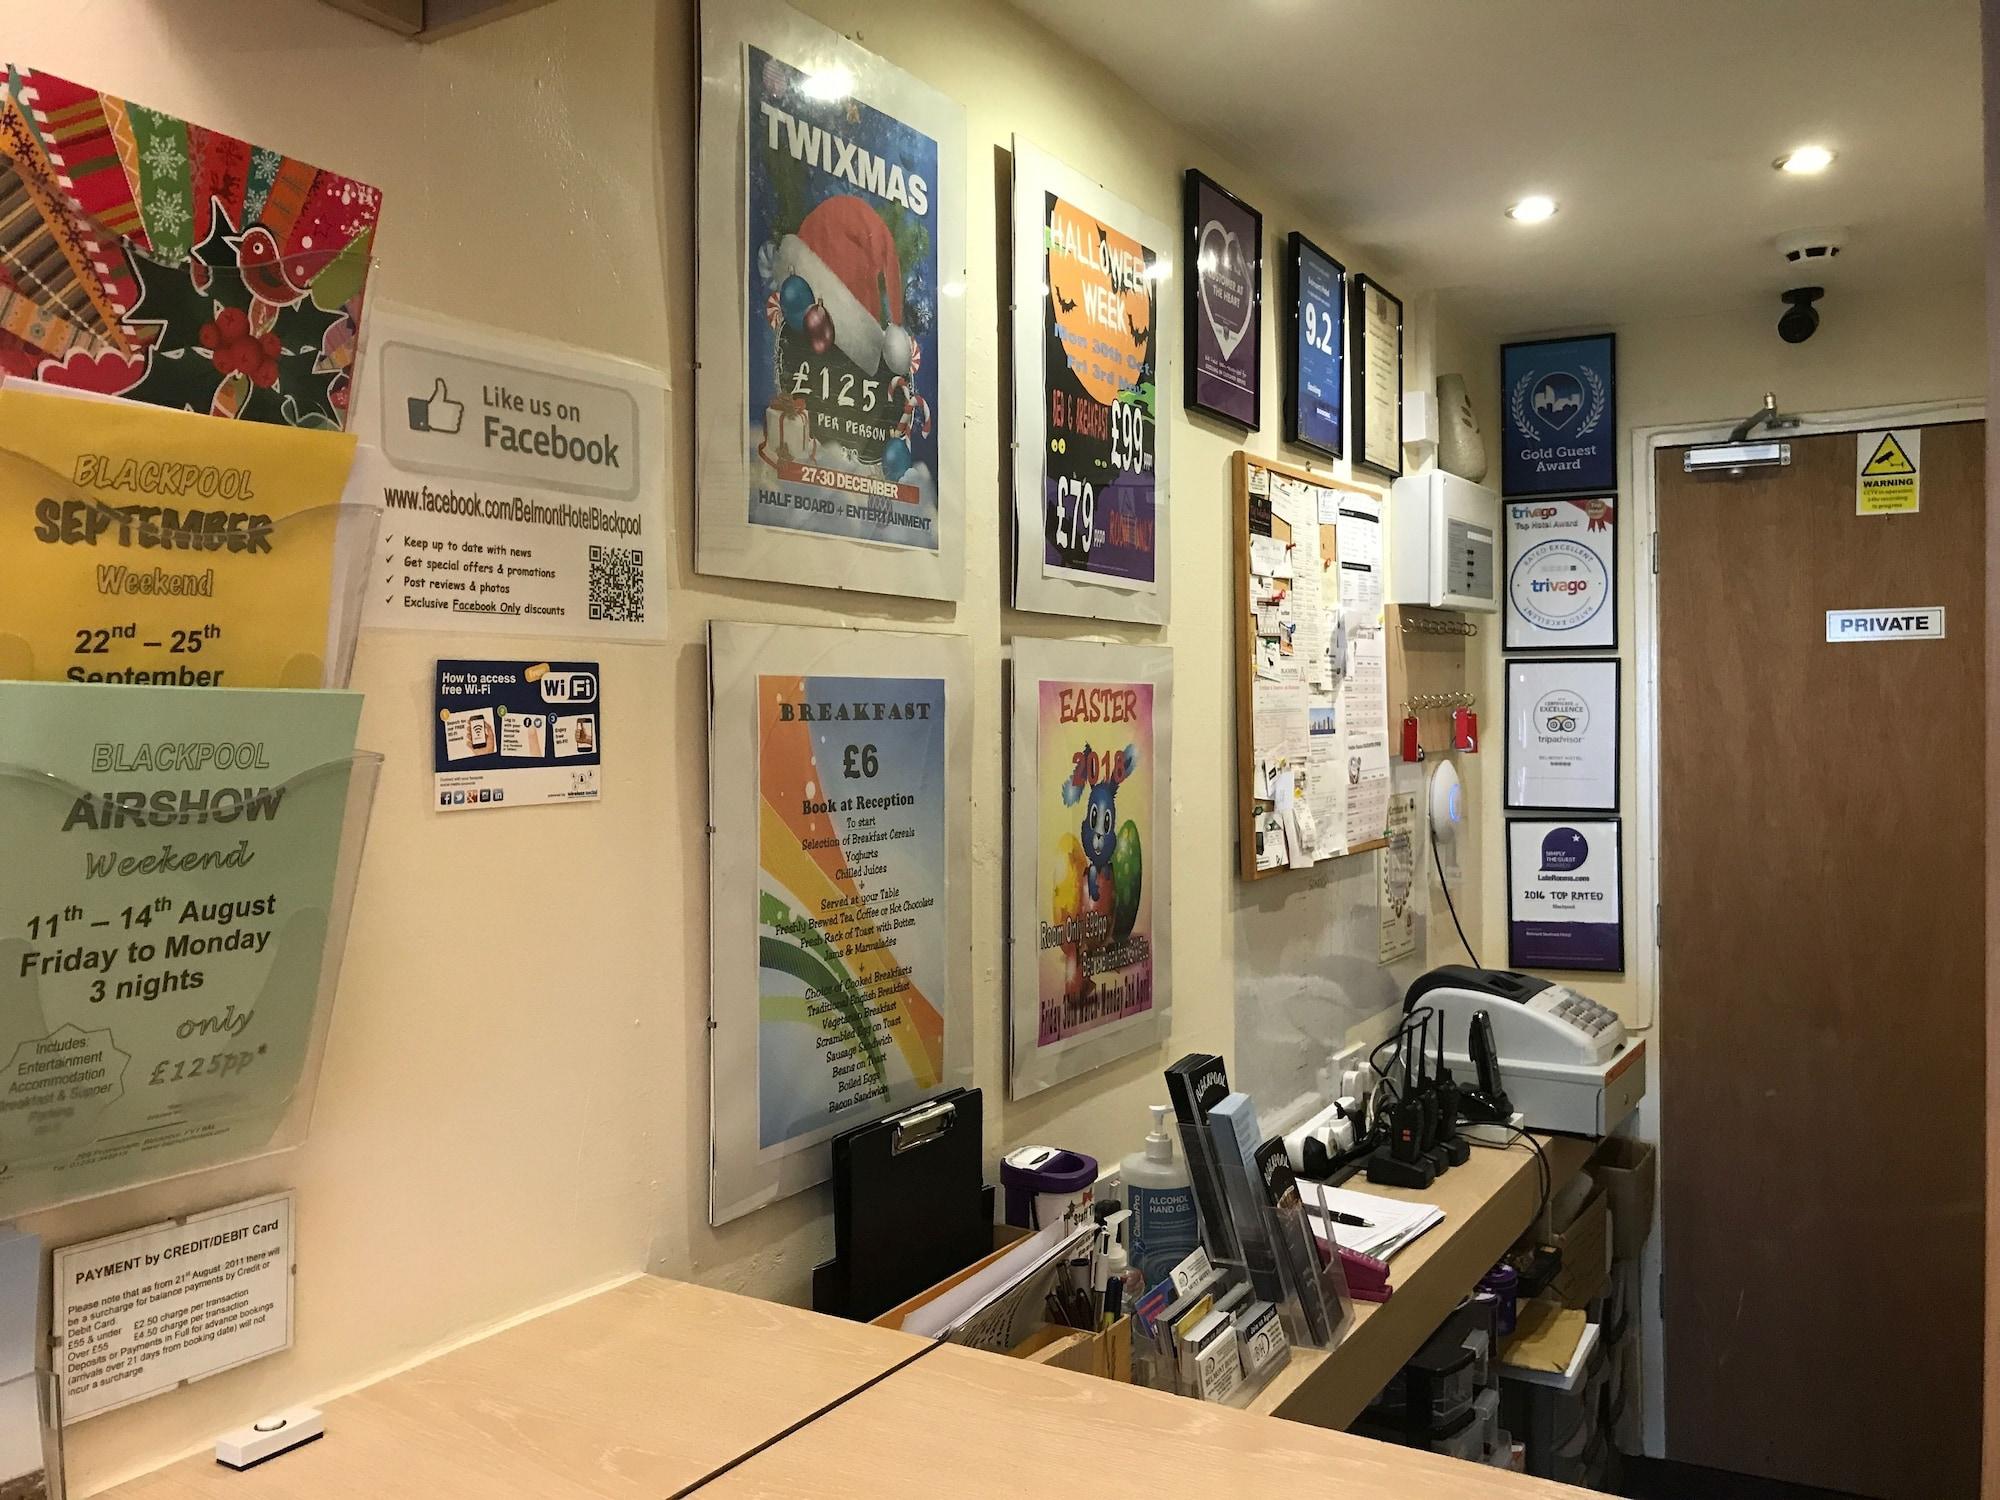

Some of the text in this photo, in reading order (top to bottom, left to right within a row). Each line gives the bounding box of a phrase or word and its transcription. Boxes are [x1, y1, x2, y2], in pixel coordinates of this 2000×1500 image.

[760, 100, 929, 216] TWIXMAS
[1082, 280, 1127, 333] WEEK
[1305, 302, 1333, 356] 9.2
[791, 360, 880, 412] £125
[482, 385, 580, 423] Like us on
[817, 411, 886, 441] PER PERSON
[1111, 398, 1144, 475] £99
[483, 415, 620, 469] Facebook
[1520, 445, 1597, 461] Gold Guest
[73, 453, 254, 500] BLACKPOOL
[1536, 459, 1581, 473] Award
[801, 465, 899, 499] 27-30 DECEMBER
[1863, 478, 1914, 488] WARNING
[384, 485, 642, 539] www.facebook.com/BelmontHotelBlackpool
[758, 489, 792, 507] HALF
[794, 496, 835, 515] BOARD
[846, 504, 931, 531] ENTERTAINMENT
[1056, 475, 1094, 553] £79
[1511, 506, 1558, 520] trivago
[33, 497, 275, 554] SEPTEMBER
[403, 535, 532, 558] Keep up to date with news
[96, 564, 214, 597] Weekend
[404, 556, 556, 579] Get special offers & promotions
[404, 576, 510, 594] Post reviews & photos
[1530, 578, 1587, 595] trivago
[404, 595, 565, 616] Exclusive Facebook Only discounts
[75, 622, 221, 654] 22nd 25th
[1840, 615, 1930, 633] PRIVATE
[441, 684, 491, 695] free Wi-Fi
[442, 672, 517, 684] How to access
[779, 702, 931, 722] BREAKFAST
[1059, 687, 1137, 724] EASTER
[1538, 735, 1583, 744] tripadvisor
[91, 742, 270, 772] BLACKPOOL
[843, 743, 879, 779] £6
[1072, 750, 1126, 787] 2018
[61, 786, 287, 832] AIRSHOW
[802, 792, 915, 815] Book at Reception
[846, 816, 876, 829] To start
[801, 827, 915, 851] Selection of Breakfast Cereals
[85, 840, 255, 880] Weekend
[845, 849, 879, 864] Yoghurts
[835, 863, 888, 881] Chilled Juices
[1537, 874, 1590, 882] LateRooms.com
[820, 895, 849, 911] Served
[861, 893, 879, 906] your
[880, 888, 900, 901] Table
[1524, 890, 1604, 901] 2016 TOP RATED
[26, 894, 276, 940] 11th 14th August
[1040, 921, 1063, 950] Room
[1066, 915, 1083, 946] Only
[19, 927, 271, 978] Friday to Monday
[89, 967, 205, 1003] 3 nights
[176, 1005, 255, 1040] only
[35, 1037, 89, 1056] Includes:
[17, 1051, 103, 1076] Entertainment
[8, 1067, 106, 1095] Accommodation
[1195, 1071, 1227, 1104] BLACKPOOL
[1149, 1195, 1189, 1205] ALCOHOL
[1149, 1203, 1190, 1214] HAND GEL
[76, 1219, 279, 1285] PAYMENT by CREDIT/DEBIT Card
[67, 1261, 270, 1327] be a surcharge for balance payments by Credit or
[68, 1300, 99, 1315] Please
[101, 1294, 121, 1305] note
[122, 1288, 140, 1300] that
[141, 1285, 152, 1295] as
[154, 1279, 173, 1290] from
[192, 1264, 221, 1280] August
[224, 1257, 244, 1270] 2011
[246, 1250, 266, 1263] there
[267, 1246, 280, 1257] will
[68, 1317, 116, 1338] Debit Card
